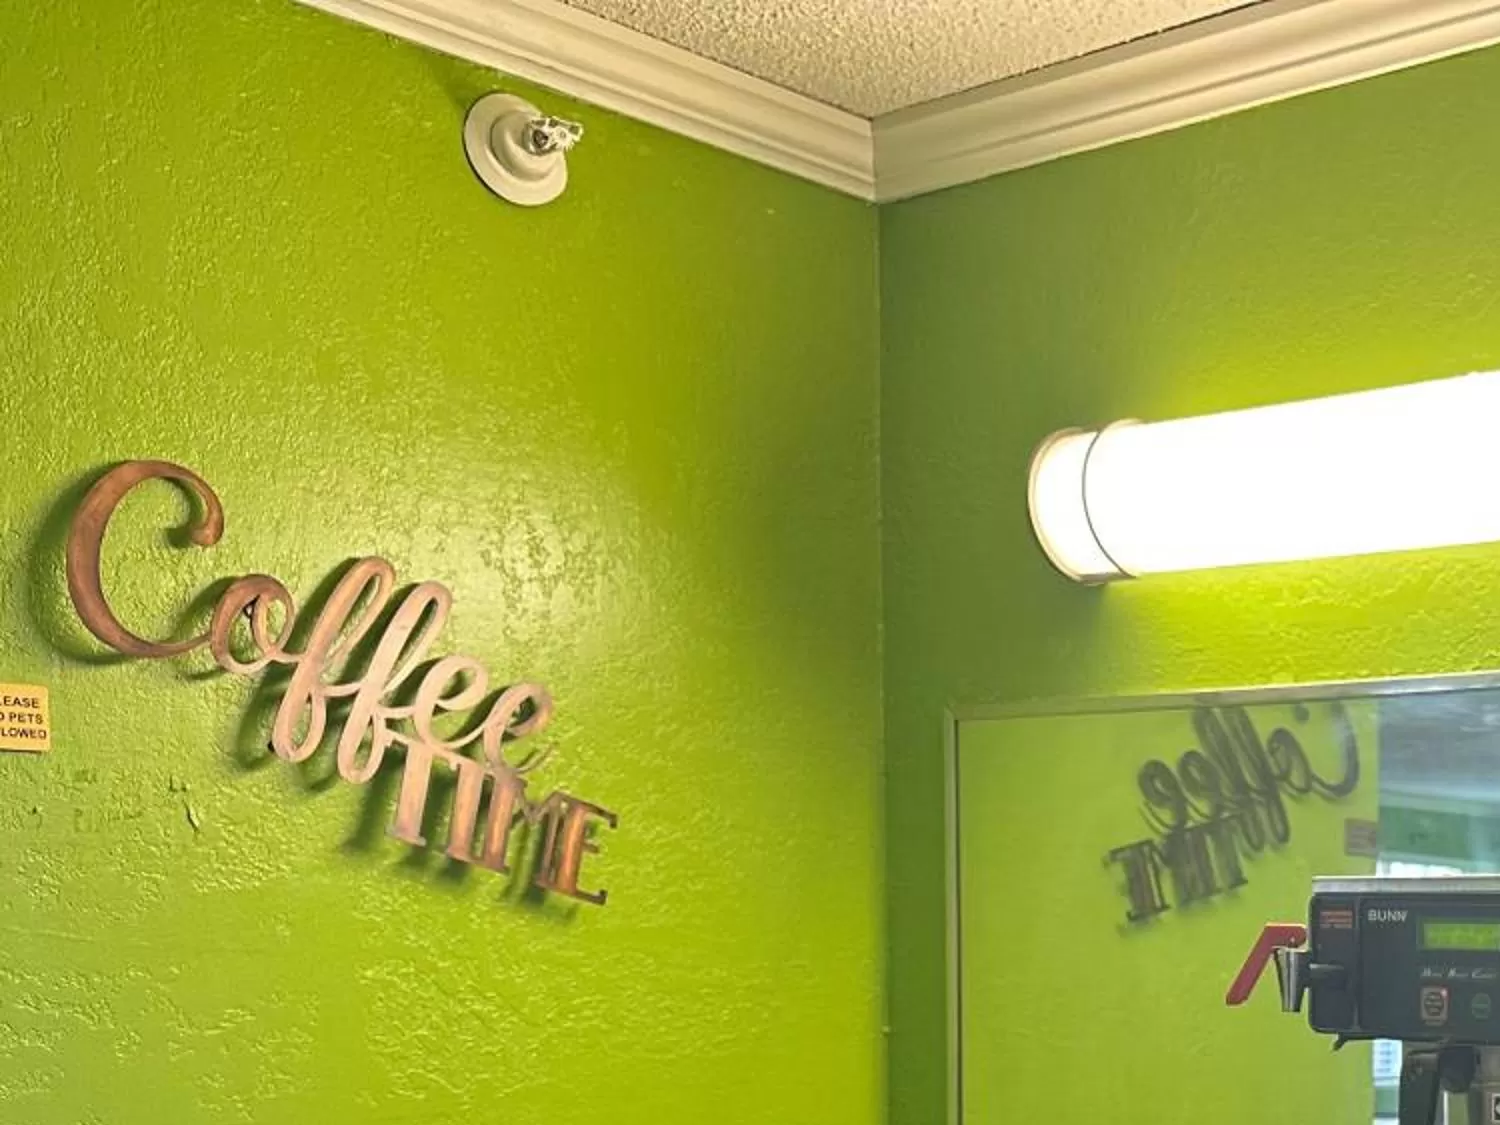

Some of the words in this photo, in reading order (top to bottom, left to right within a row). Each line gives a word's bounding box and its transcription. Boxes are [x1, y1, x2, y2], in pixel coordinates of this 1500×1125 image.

[66, 459, 560, 784] Coffee
[0, 695, 40, 709] EASE
[9, 711, 43, 725] PETS
[1, 726, 47, 740] LOWED
[384, 720, 618, 907] TIME
[1367, 908, 1409, 923] BUNN
